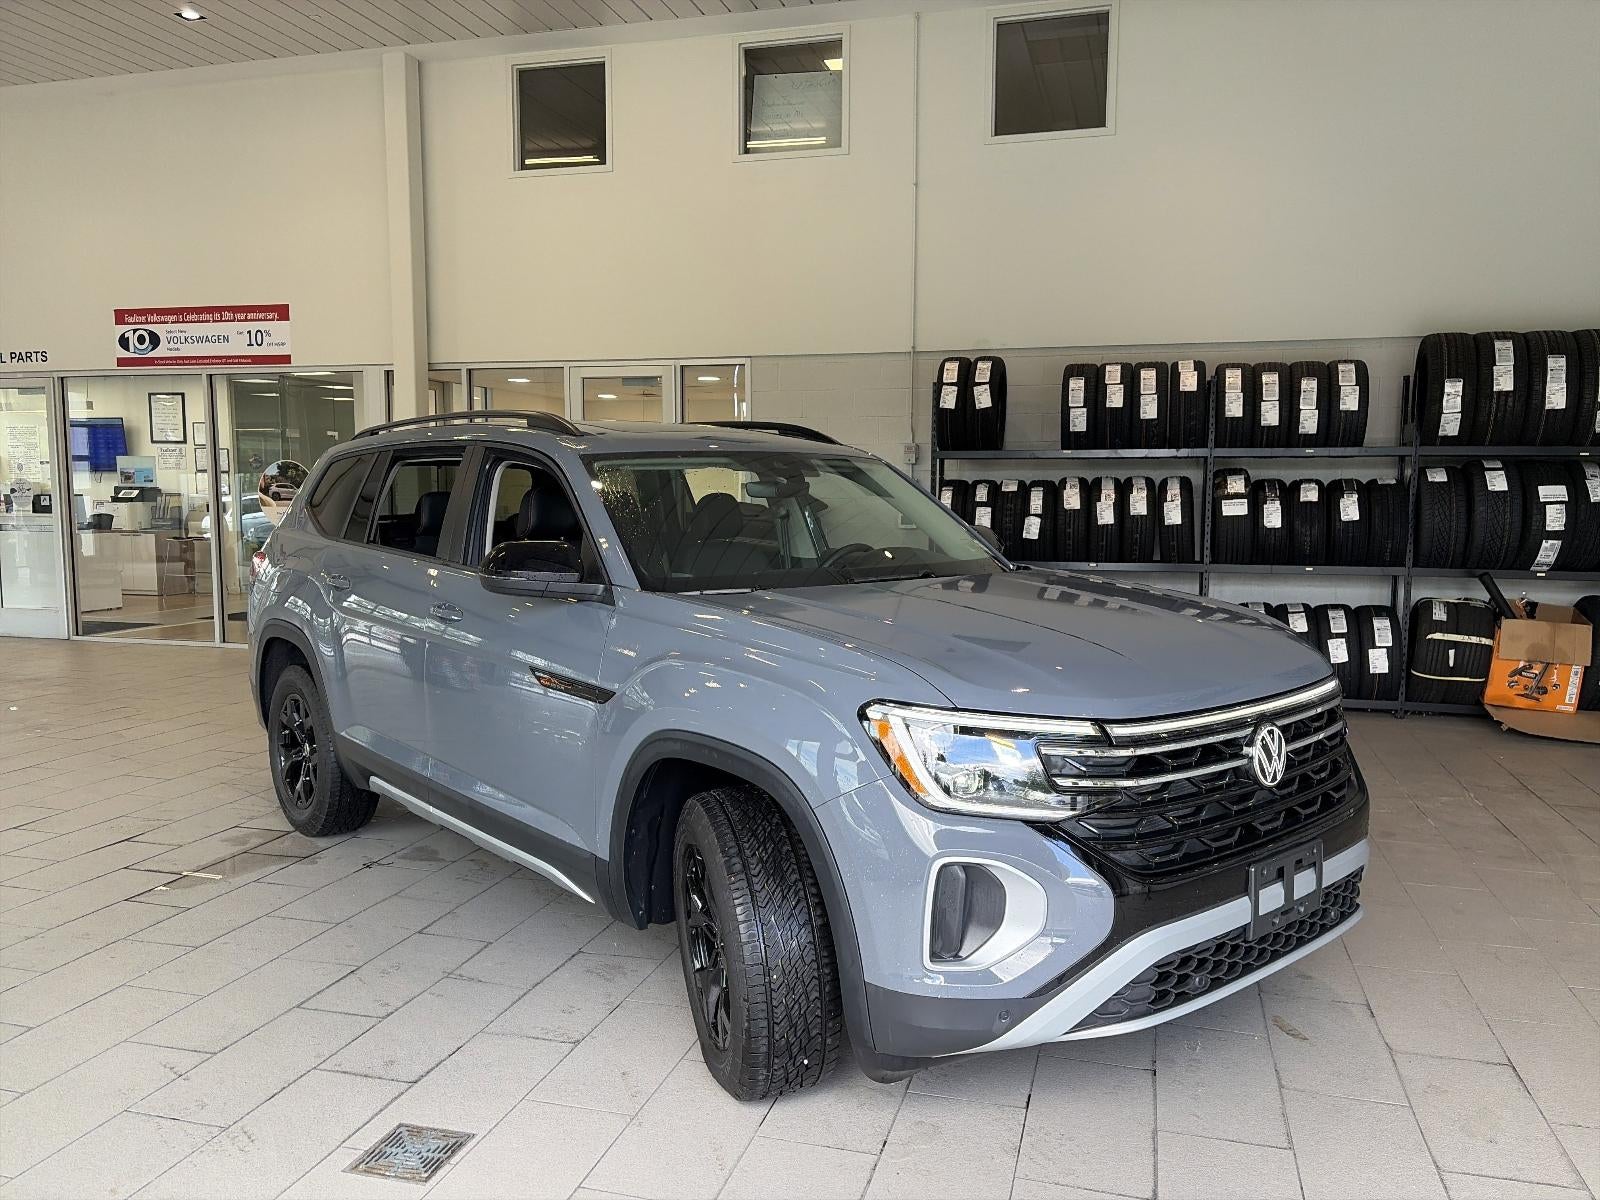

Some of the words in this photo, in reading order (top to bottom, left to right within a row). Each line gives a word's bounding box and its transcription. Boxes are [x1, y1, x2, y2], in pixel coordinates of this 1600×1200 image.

[147, 312, 178, 324] Volkswagen
[178, 312, 183, 322] is
[183, 312, 213, 324] Celebrating
[221, 311, 234, 321] 10th
[234, 312, 246, 323] year
[165, 334, 230, 345] VOLKSWAGEN
[10, 351, 48, 363] PARTS
